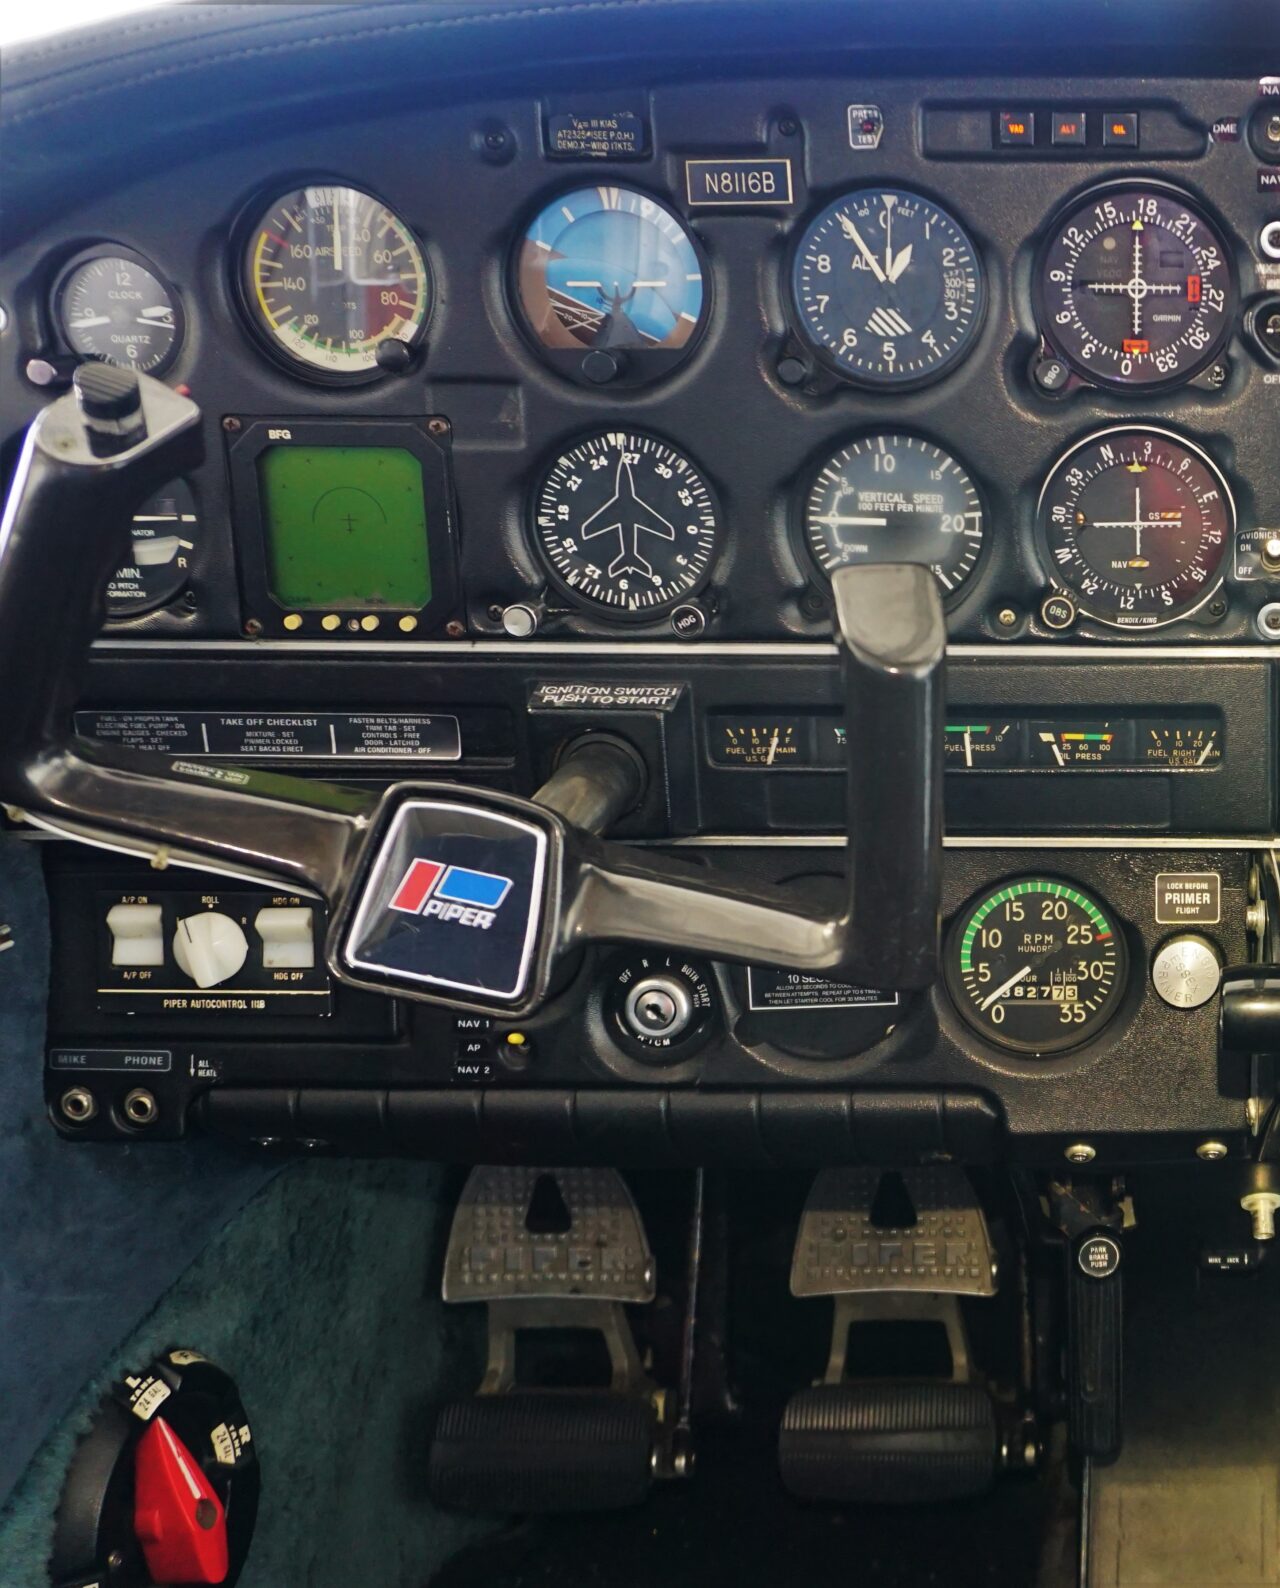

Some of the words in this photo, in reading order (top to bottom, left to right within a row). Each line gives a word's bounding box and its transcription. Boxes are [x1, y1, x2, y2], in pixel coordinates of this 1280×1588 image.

[1113, 124, 1126, 135] OIL
[1213, 124, 1237, 133] DME
[705, 171, 776, 194] N8116B
[1095, 202, 1116, 221] 15
[1138, 198, 1157, 215] 18
[1175, 214, 1197, 235] 21
[1063, 227, 1084, 249] 12
[289, 244, 312, 259] 160
[374, 251, 392, 264] 60
[943, 248, 956, 267] 2
[1201, 247, 1221, 270] 24
[817, 255, 831, 273] 8
[115, 272, 131, 286] 12
[282, 277, 306, 291] 140
[107, 290, 143, 300] CLOCK
[381, 291, 399, 306] 80
[1208, 288, 1224, 312] 27
[110, 334, 151, 345] QUARTZ
[126, 344, 138, 358] 6
[883, 342, 896, 360] 5
[268, 429, 292, 440] BFG
[590, 455, 608, 470] 24
[874, 454, 896, 473] 10
[654, 463, 672, 479] 30
[858, 492, 905, 503] VERTICAL
[913, 494, 943, 505] SPEED
[1052, 506, 1066, 523] 30
[1149, 513, 1160, 521] GS
[941, 514, 965, 532] 20
[1049, 605, 1068, 619] OBS
[540, 685, 610, 696] IGNITION
[613, 686, 677, 697] SWITCH
[542, 694, 587, 704] PUSH
[592, 695, 614, 704] TO
[616, 696, 671, 706] START
[267, 719, 317, 727] CHECKLIST
[726, 747, 746, 755] FUEL
[1075, 753, 1102, 761] PRESS
[1148, 749, 1169, 757] FUEL
[1167, 882, 1183, 890] LOCK
[1185, 883, 1209, 891] BEFORE
[1165, 893, 1211, 905] PRIMER
[422, 899, 496, 930] PIPER
[1005, 902, 1025, 921] 15
[1041, 901, 1068, 921] 20
[1176, 907, 1200, 916] FLIGHT
[982, 929, 1002, 948] 10
[1023, 935, 1053, 944] RPM
[1067, 926, 1093, 945] 25
[681, 964, 699, 982] BOTH
[979, 963, 991, 982] 5
[1077, 961, 1104, 981] 30
[163, 999, 187, 1009] PIPER
[191, 999, 248, 1009] AUTOCONTROL
[992, 1005, 1005, 1024] 0
[1060, 1004, 1087, 1023] 35
[457, 1019, 479, 1029] NAV
[58, 1055, 87, 1065] MIKE
[124, 1055, 164, 1066] PHONE
[457, 1065, 479, 1075] NAV
[1088, 1253, 1109, 1261] BRAKE
[1090, 1246, 1107, 1254] PARK
[1090, 1260, 1108, 1268] PUSH
